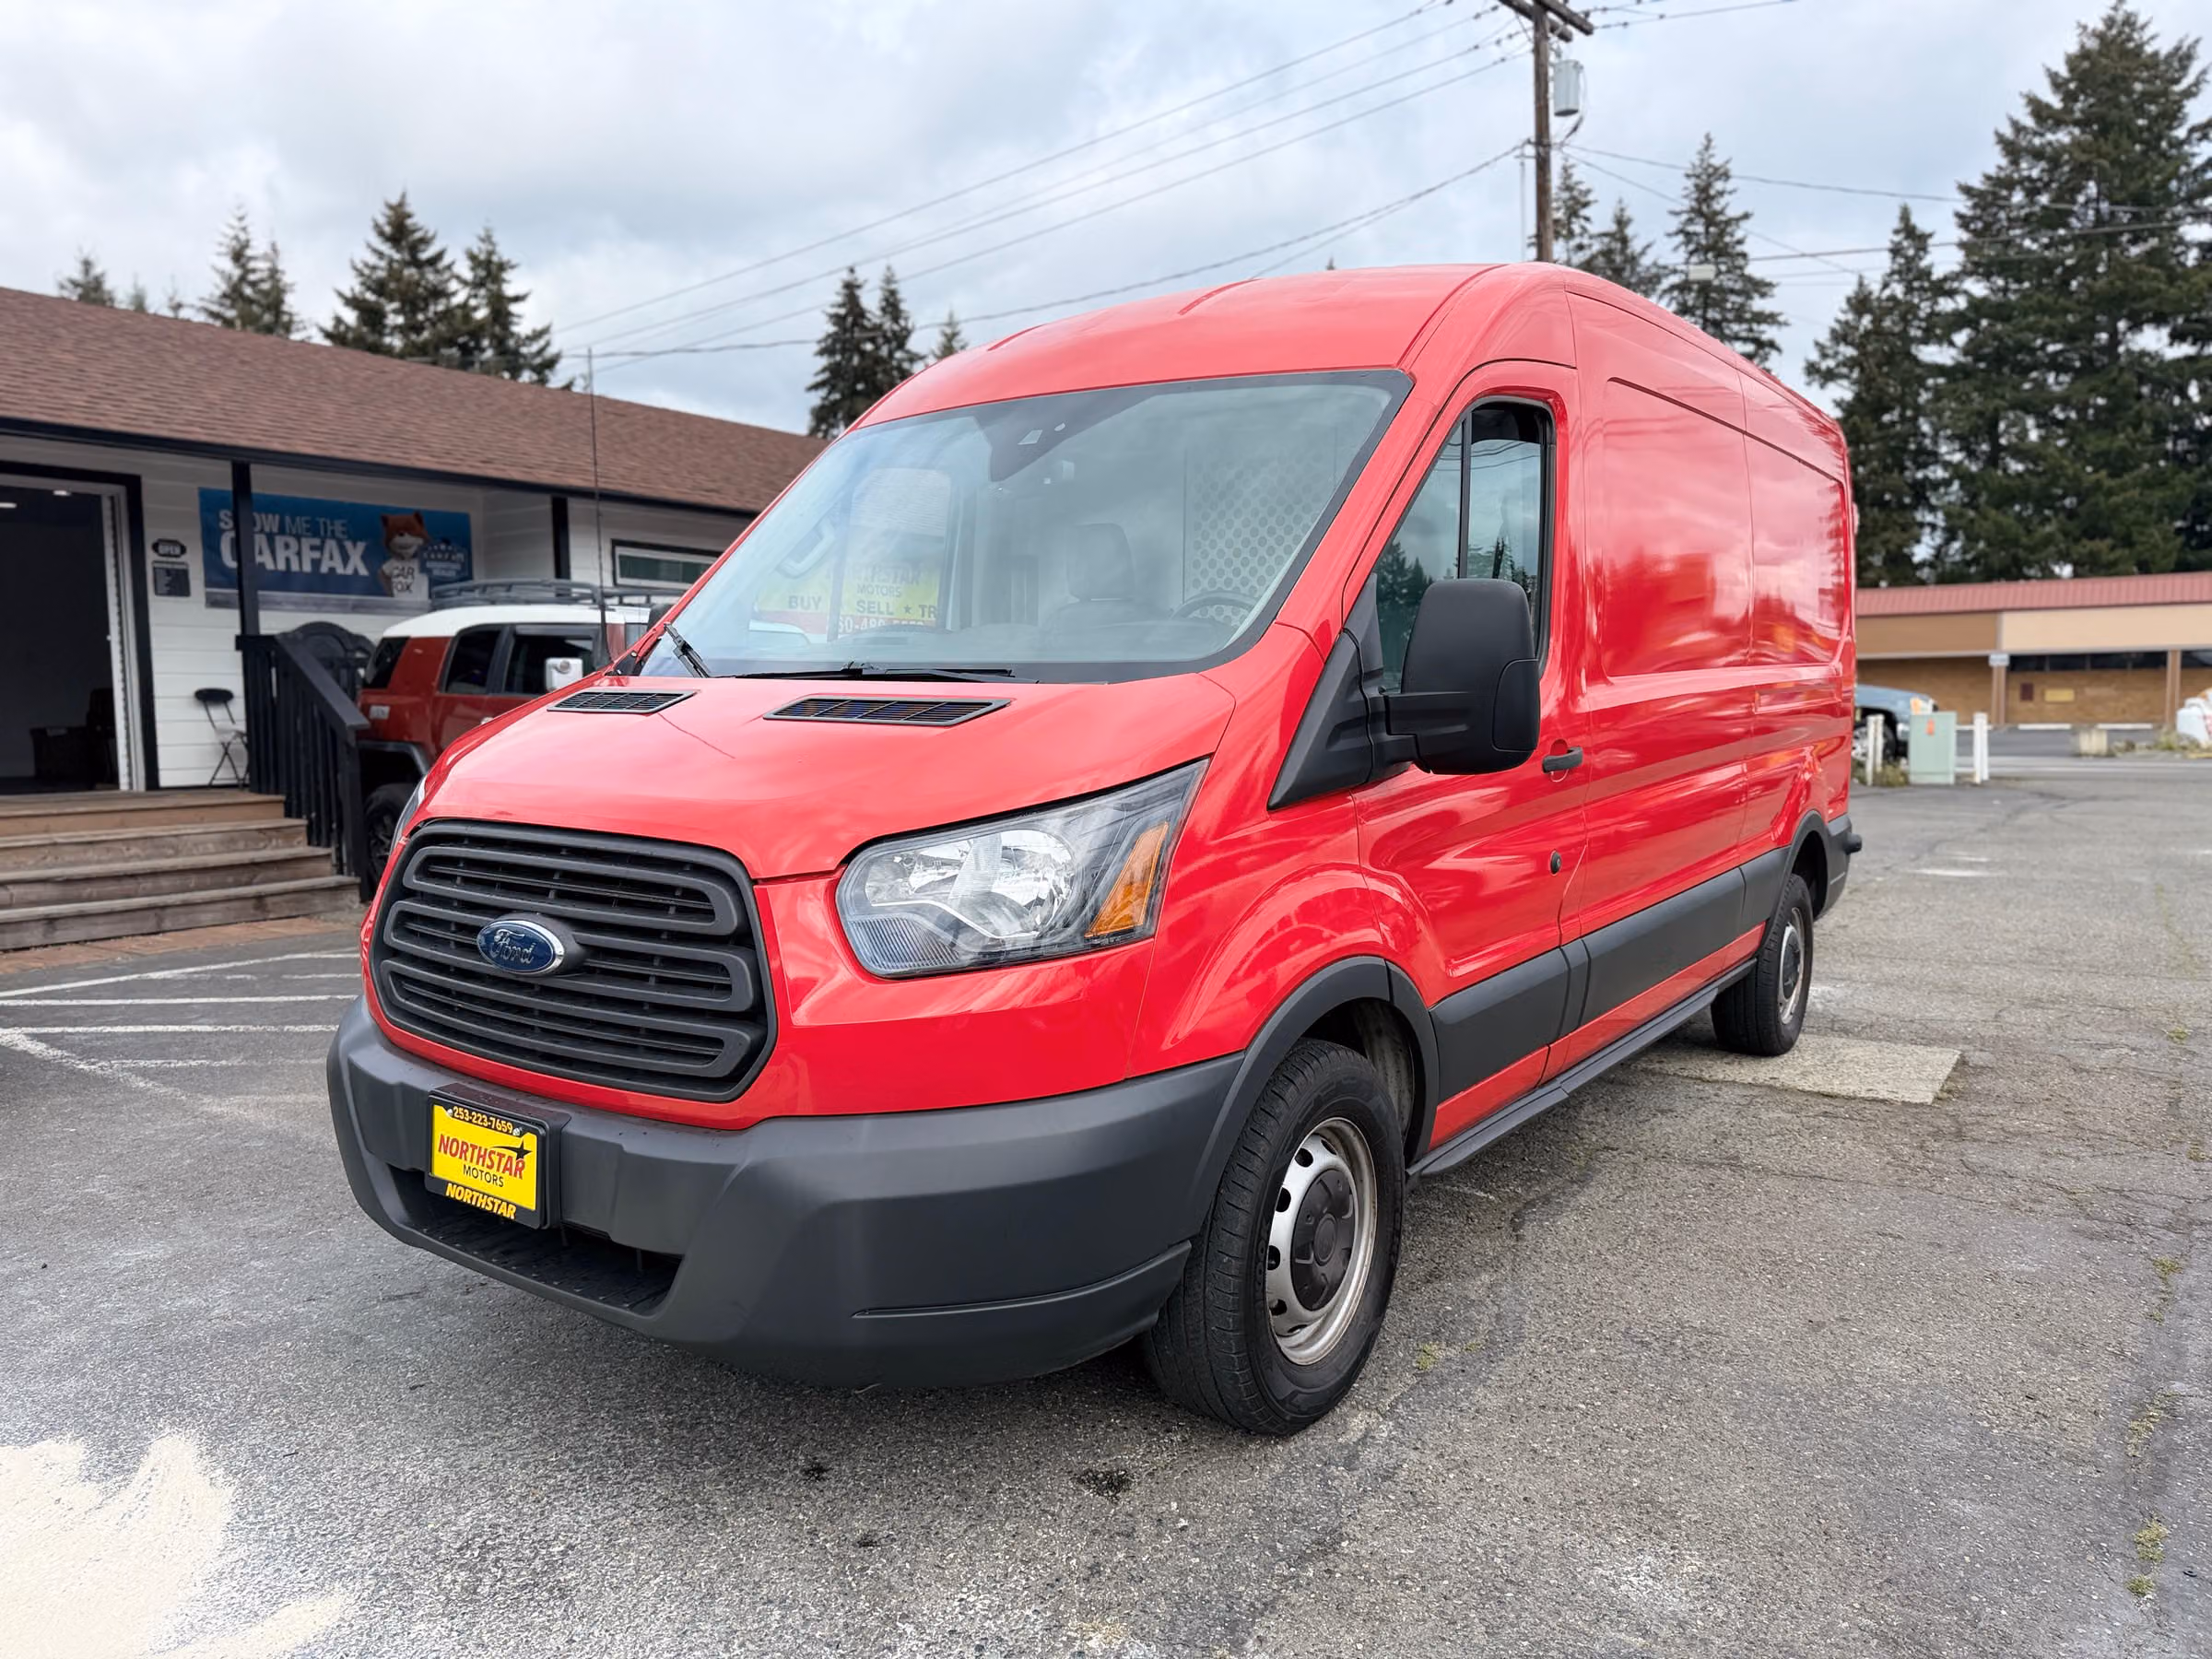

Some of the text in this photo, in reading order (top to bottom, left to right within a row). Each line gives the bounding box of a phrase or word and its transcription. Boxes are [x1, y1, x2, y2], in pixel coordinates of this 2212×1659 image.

[218, 510, 348, 539] SOW ME THE
[219, 530, 369, 576] CARFAX
[392, 566, 415, 581] CAR
[856, 583, 903, 599] MOTORS
[788, 594, 822, 611] BUY
[856, 599, 894, 617] SELL
[489, 928, 536, 964] Ford
[453, 1106, 513, 1134] 253-223-7659
[438, 1134, 525, 1180] NORTHSTAR
[463, 1164, 504, 1188] MOTORS
[445, 1182, 517, 1220] NORTHSTAR
